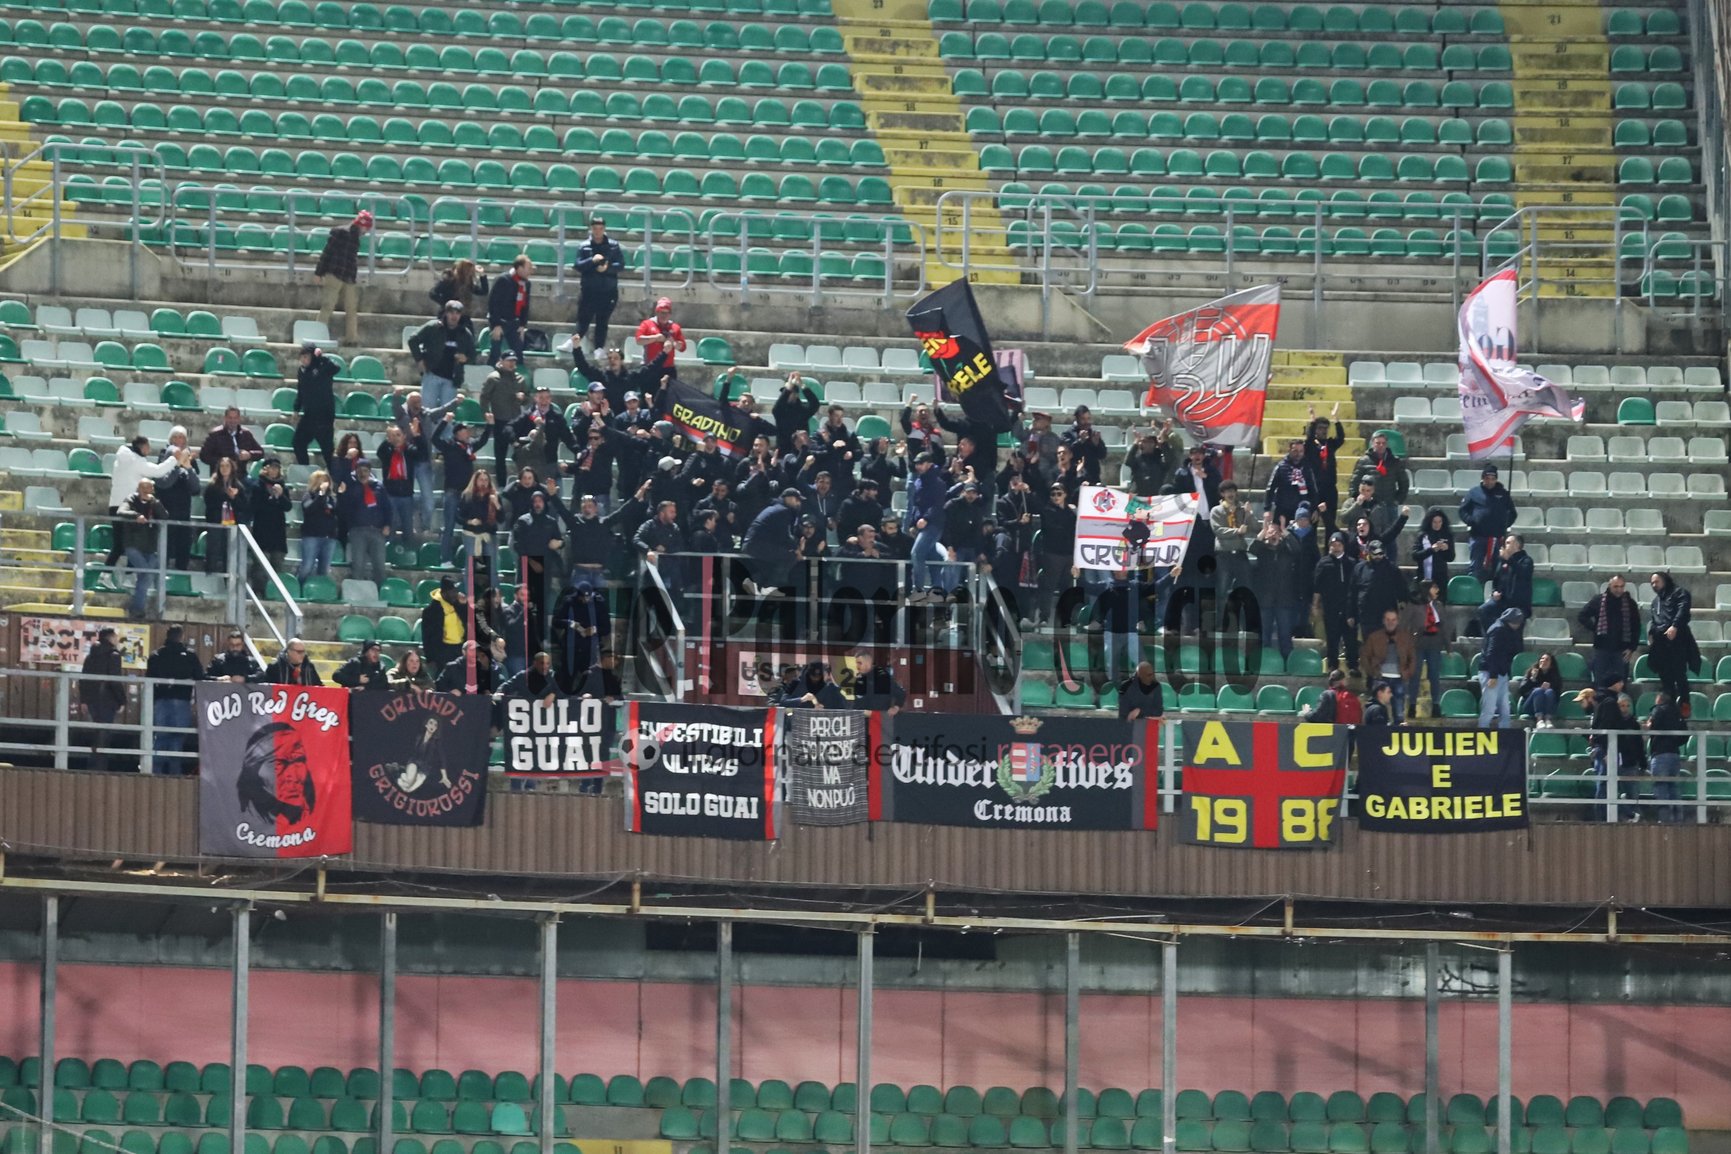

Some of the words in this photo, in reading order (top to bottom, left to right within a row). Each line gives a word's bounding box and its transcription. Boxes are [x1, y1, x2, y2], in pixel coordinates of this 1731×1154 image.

[919, 140, 929, 149] 17
[1562, 155, 1574, 164] 17
[1565, 268, 1576, 278] 14
[206, 693, 242, 727] Old
[248, 690, 289, 716] Red
[508, 699, 603, 733] SOLO
[639, 721, 763, 748] INGESTIBILI
[1193, 720, 1242, 765] A
[1293, 722, 1334, 768] C
[1382, 731, 1499, 757] JULIEN
[511, 736, 603, 771] GUAI
[662, 754, 739, 776] ULTRAS
[890, 743, 998, 789] Under
[823, 764, 842, 785] MA
[1432, 764, 1453, 788] E
[368, 763, 480, 817] GRIGIOROSSI
[644, 791, 700, 816] SOLO
[704, 792, 759, 819] GUAI
[974, 799, 1072, 823] Cremona
[1365, 793, 1523, 820] GABRIELE
[236, 822, 316, 849] Cremona
